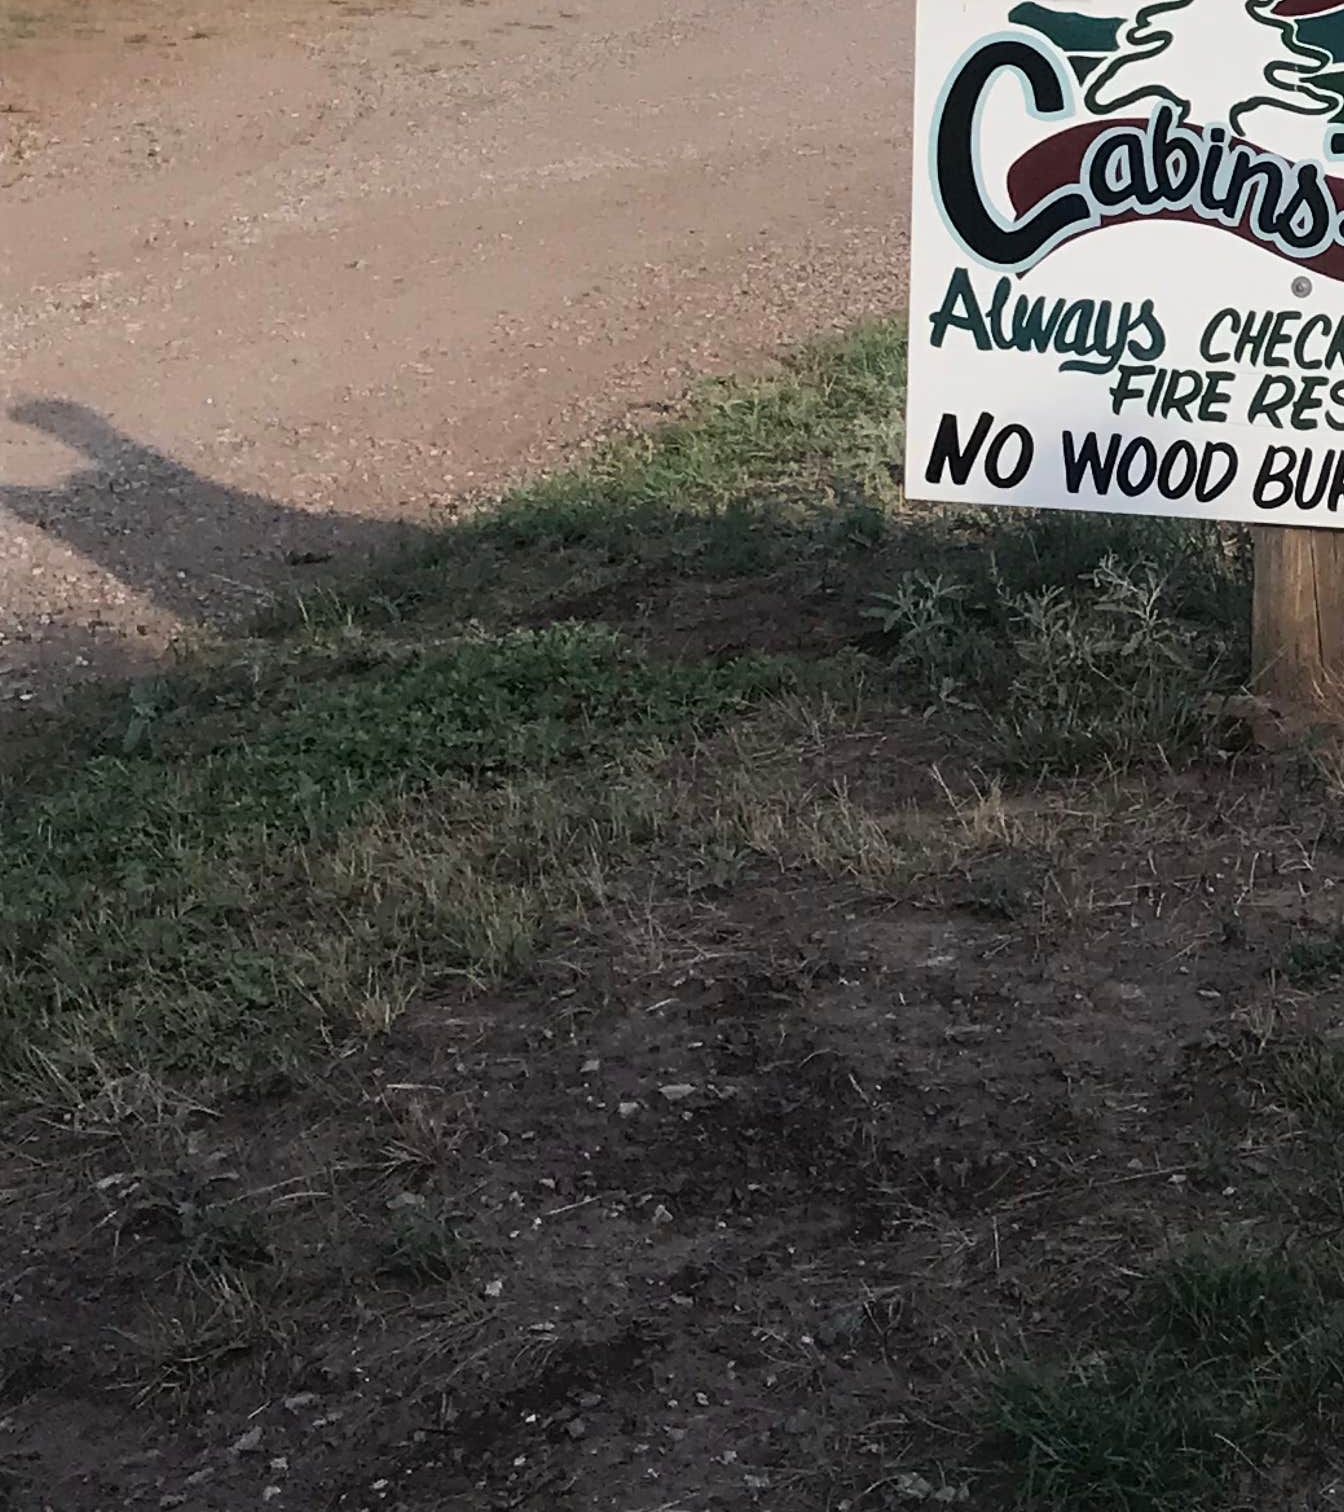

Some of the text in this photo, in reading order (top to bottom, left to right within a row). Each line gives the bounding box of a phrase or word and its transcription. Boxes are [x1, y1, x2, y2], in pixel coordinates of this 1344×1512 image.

[929, 267, 1166, 376] Always
[1109, 364, 1237, 424] FIRE
[924, 411, 1035, 489] NO
[1061, 430, 1239, 503] WOOD
